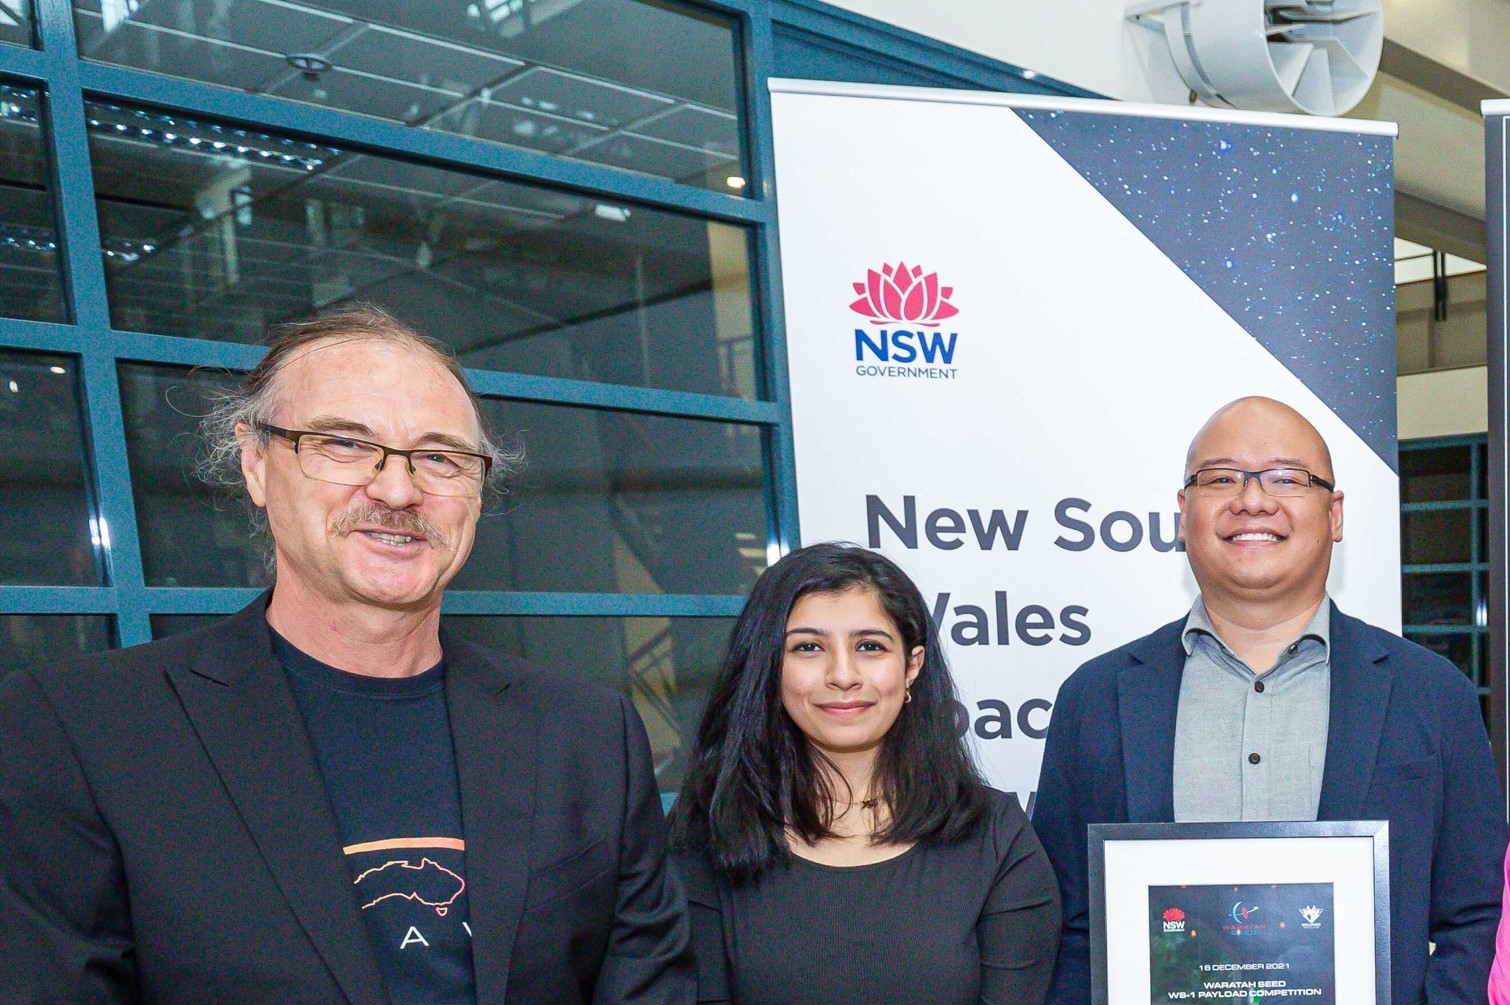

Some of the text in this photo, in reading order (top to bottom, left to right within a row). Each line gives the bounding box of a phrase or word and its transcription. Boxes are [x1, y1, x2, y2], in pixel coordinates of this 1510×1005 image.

[854, 328, 958, 364] NSW
[856, 365, 958, 379] GOVERNMENT
[865, 494, 1029, 551] New
[929, 591, 1092, 646] ales
[1163, 921, 1185, 929] NSW
[1212, 963, 1264, 971] DECEMBER
[1204, 980, 1287, 989] WARATAH SEED
[1198, 990, 1248, 998] PAYLOAD
[1249, 988, 1322, 997] COMPETITION
